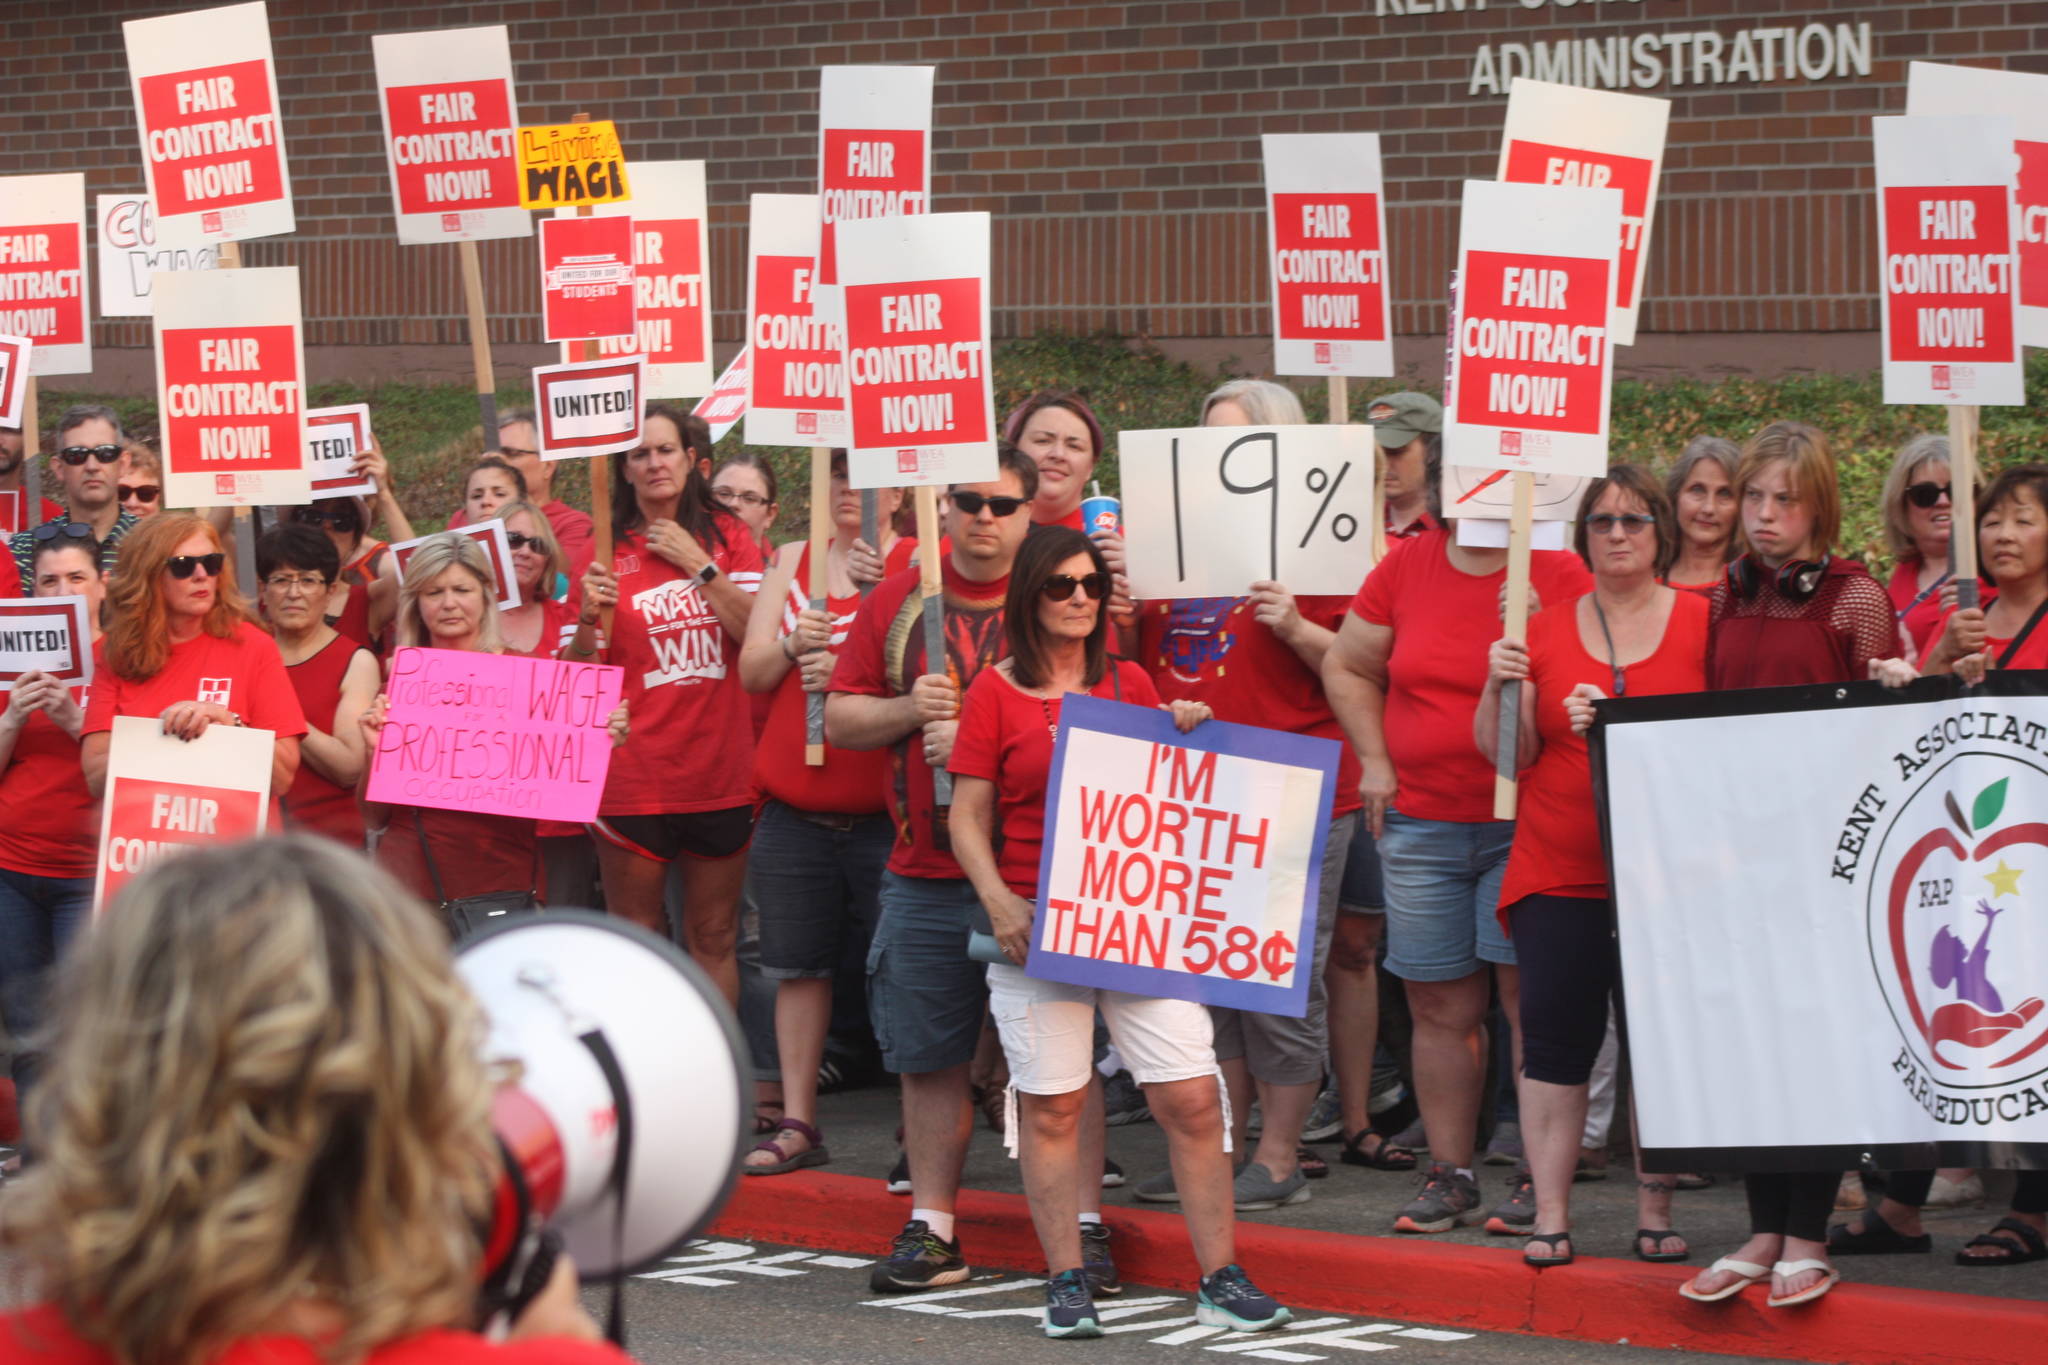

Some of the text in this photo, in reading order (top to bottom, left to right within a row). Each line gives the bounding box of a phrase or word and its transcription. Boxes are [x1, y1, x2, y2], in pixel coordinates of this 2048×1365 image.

[1469, 22, 1872, 96] ADMINISTRATION
[176, 76, 237, 115] FAIR
[419, 91, 477, 124] FAIR
[150, 113, 274, 163] CONTRACT
[393, 128, 512, 165] CONTRACT
[847, 142, 895, 178] FAIR
[183, 160, 254, 201] NOW!
[425, 169, 493, 202] NOW!
[823, 189, 924, 224] CONTRACT
[1302, 205, 1351, 238] FAIR
[1919, 200, 1977, 240] FAIR
[0, 234, 50, 264] FAIR
[635, 232, 664, 264] IR
[1277, 249, 1381, 284] CONTRACT
[0, 269, 80, 301] NTRACT
[562, 284, 618, 298] STUDENTS
[637, 274, 701, 309] RACT
[1502, 267, 1569, 310] FAIR
[1888, 253, 2010, 295] CONTRACT
[0, 307, 57, 336] NOW!
[880, 293, 943, 334] FAIR
[1302, 294, 1360, 329] NOW!
[1917, 307, 1985, 348] NOW!
[755, 314, 841, 350] CONTR
[1462, 317, 1605, 366] CONTRACT
[200, 338, 260, 372] FAIR
[850, 340, 982, 385] CONTRACT
[784, 362, 844, 398] NOW
[1488, 373, 1568, 418] NOW!
[168, 381, 297, 418] CONTRACT
[554, 389, 632, 418] UNITED!
[881, 392, 955, 434] NOW!
[200, 426, 271, 460] NOW!
[310, 438, 353, 461] TED!
[0, 629, 67, 652] NITED!
[649, 626, 722, 674] WIN
[528, 661, 615, 729] WAGE
[1146, 741, 1217, 804] I'M
[151, 793, 219, 834] FAIR
[1831, 711, 2048, 884] KENT ASSOCIAT
[1080, 785, 1269, 869] WORTH
[1079, 846, 1233, 921] MORE
[1918, 878, 1953, 908] KAP
[1048, 898, 1296, 981] THAN 58¢
